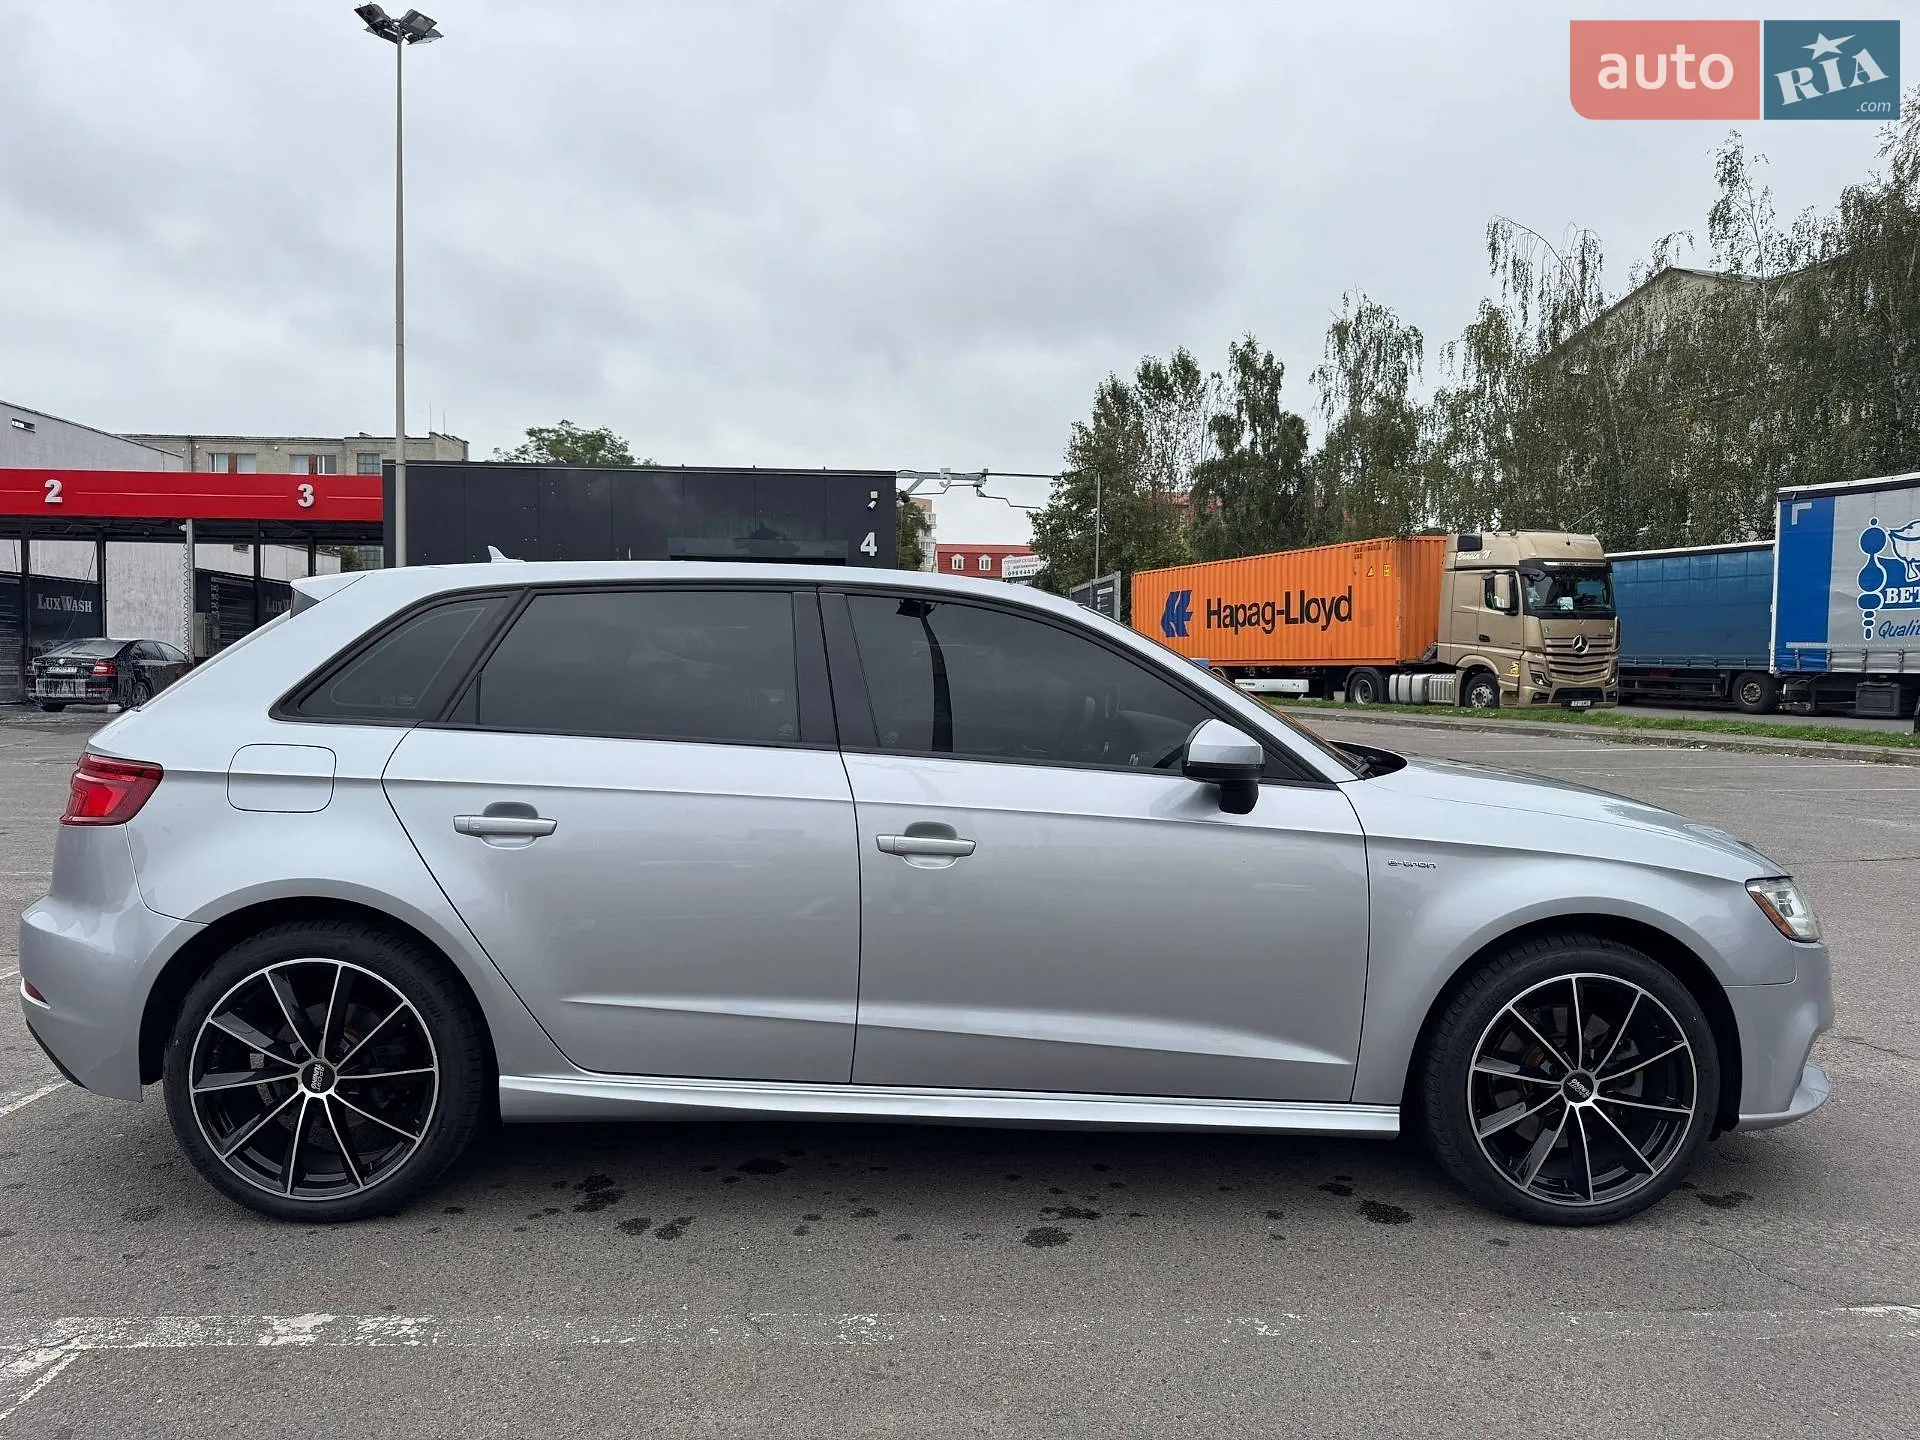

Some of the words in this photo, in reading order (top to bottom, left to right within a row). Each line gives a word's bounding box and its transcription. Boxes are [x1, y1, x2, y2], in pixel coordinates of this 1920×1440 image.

[43, 478, 63, 504] 2
[297, 483, 315, 508] 3
[859, 531, 878, 557] 4
[1206, 585, 1353, 636] Hapag-Lloyd
